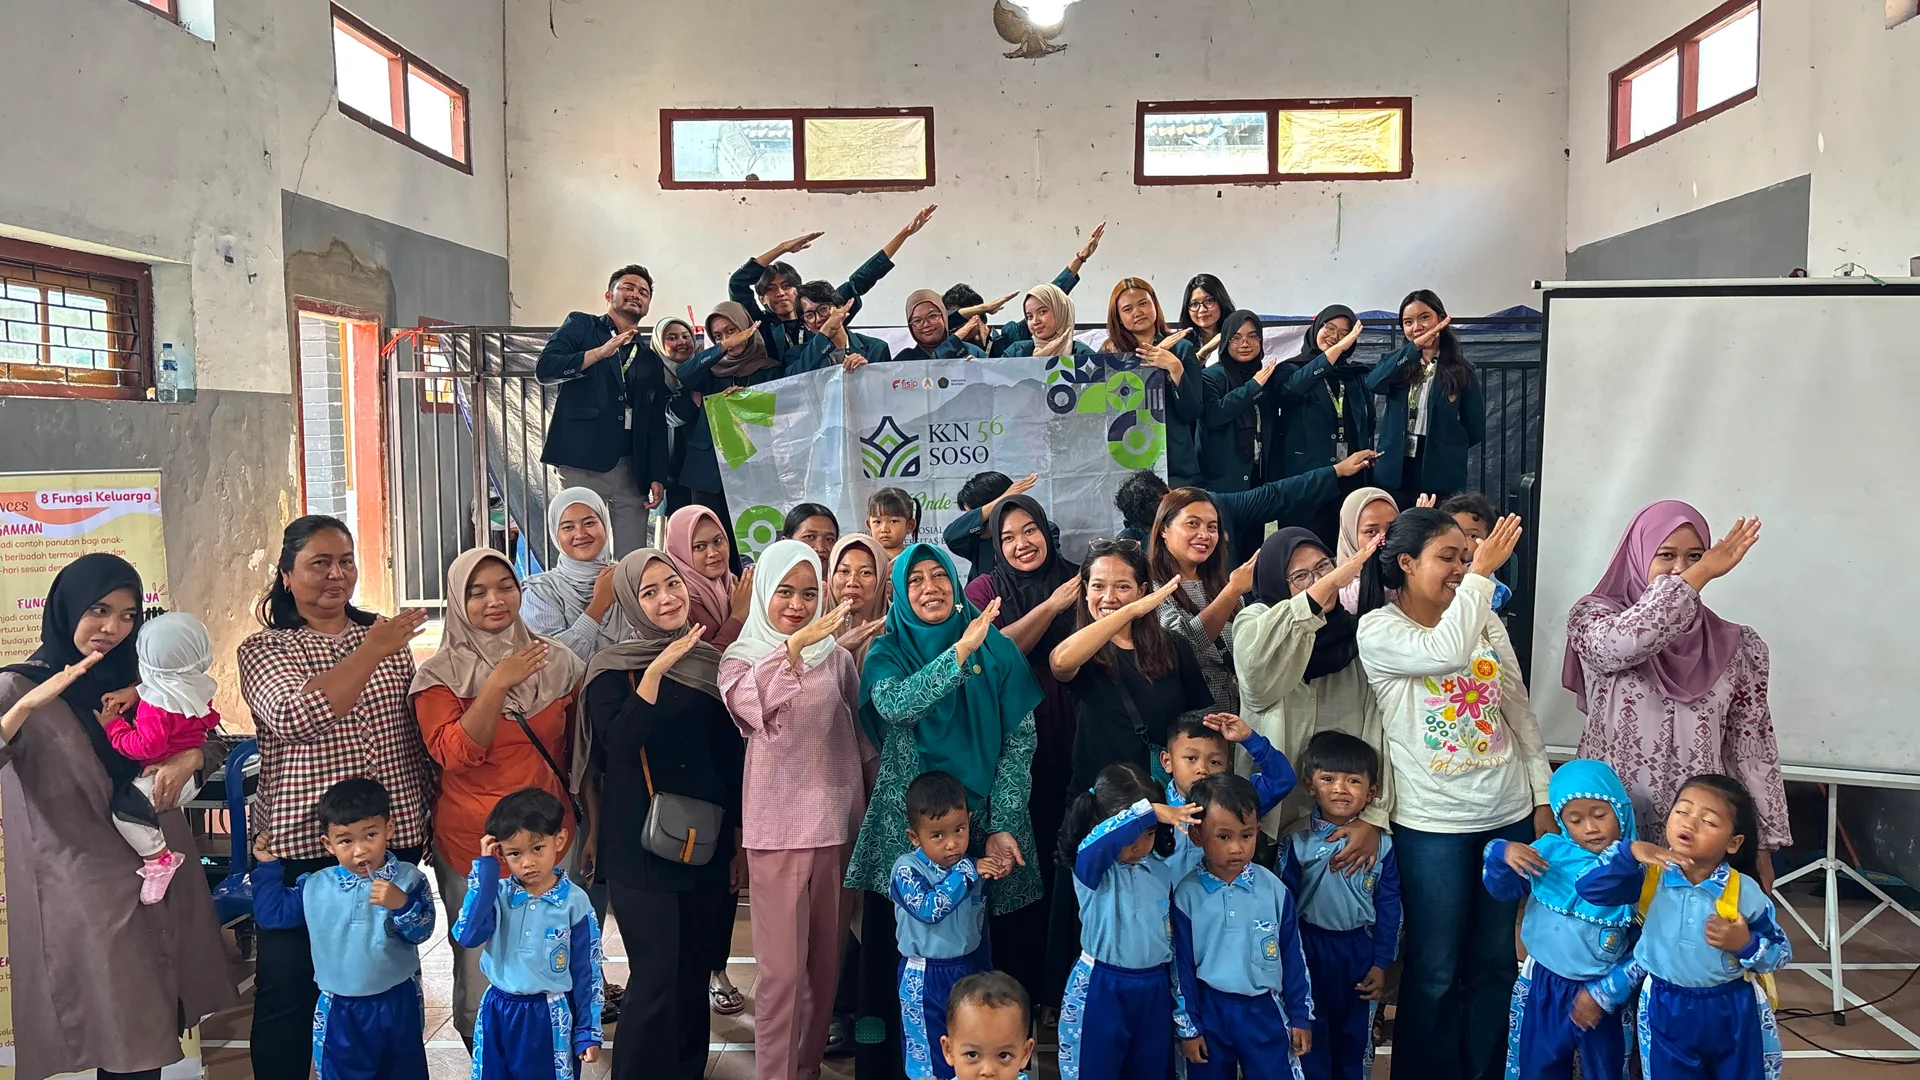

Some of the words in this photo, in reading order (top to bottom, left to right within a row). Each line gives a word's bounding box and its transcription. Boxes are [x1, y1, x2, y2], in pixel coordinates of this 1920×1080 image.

[928, 423, 969, 443] KKN
[976, 414, 1004, 443] 56
[929, 445, 989, 466] SOSO
[41, 493, 49, 504] 8
[52, 492, 92, 505] Fungsi
[96, 491, 151, 503] Keluarga
[919, 526, 943, 535] OSIAL
[15, 539, 44, 548] contoh
[45, 538, 79, 548] panutan
[81, 537, 100, 546] bagi
[101, 536, 124, 544] anak-
[5, 551, 46, 560] beribadah
[21, 564, 46, 573] sesuai
[48, 563, 64, 572] den
[2, 637, 33, 646] budaya
[1430, 753, 1511, 776] bloom
